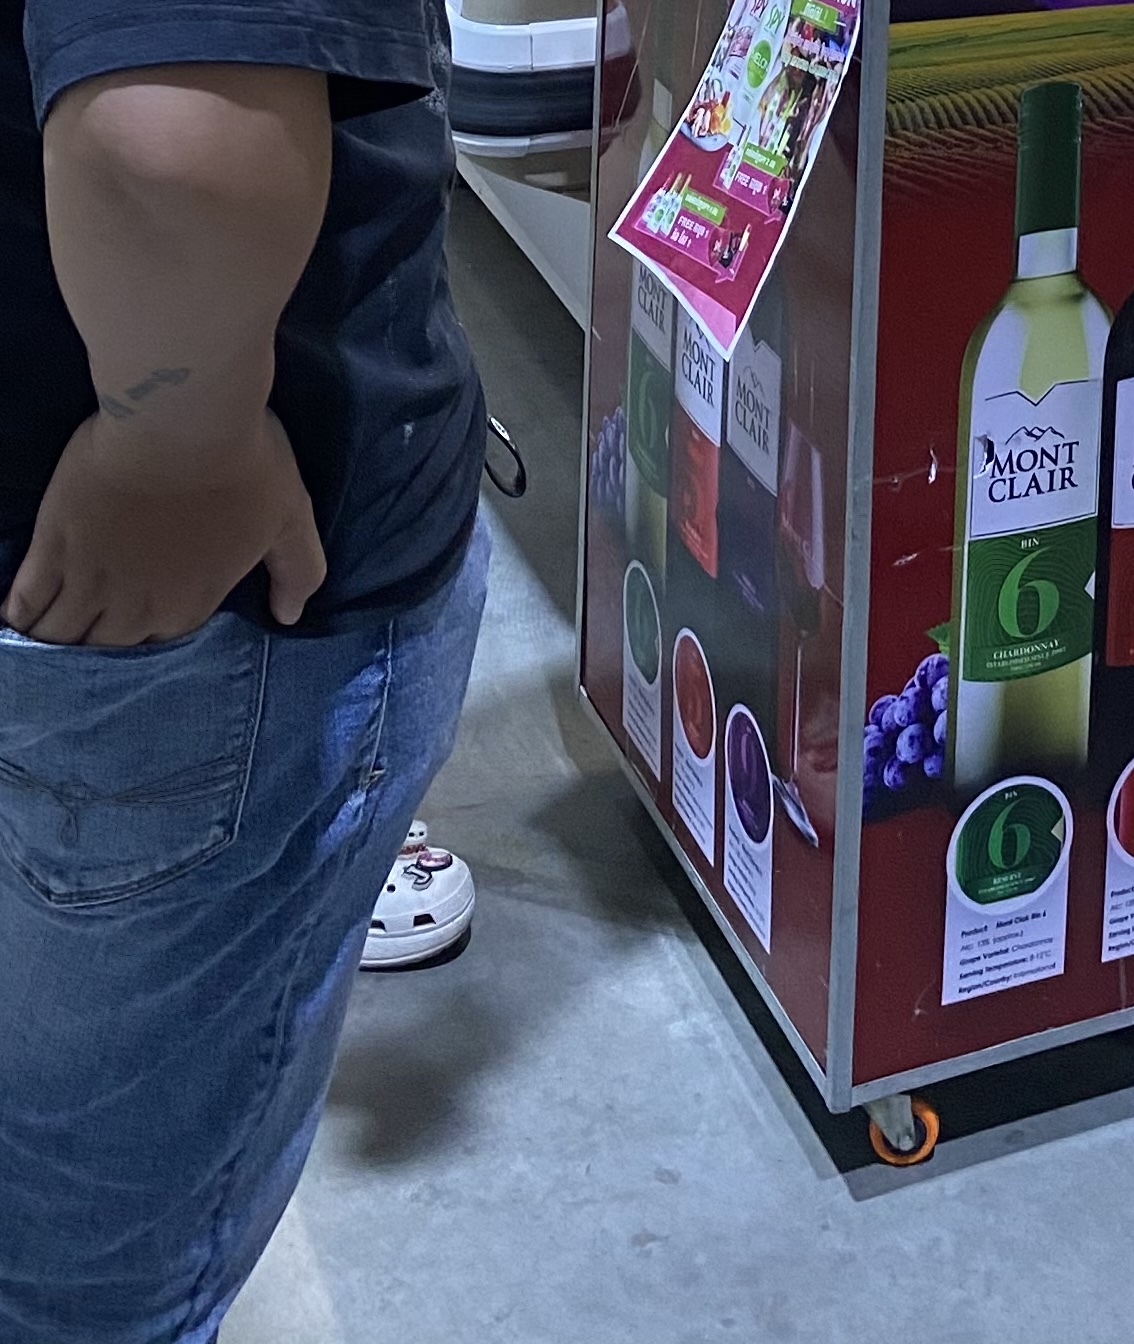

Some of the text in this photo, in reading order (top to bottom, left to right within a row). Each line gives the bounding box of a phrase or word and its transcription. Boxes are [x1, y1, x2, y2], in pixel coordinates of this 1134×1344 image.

[637, 285, 666, 334] CLAIR
[682, 330, 717, 382] MONT
[681, 354, 715, 408] CLAIR
[735, 378, 771, 425] MONT
[734, 401, 770, 454] CLAIR
[989, 440, 1080, 480] MONT
[988, 466, 1079, 504] CLAIR
[1020, 537, 1040, 550] BIN
[998, 546, 1060, 638] 6
[992, 639, 1060, 661] CHARDONNAY
[988, 798, 1031, 870] 6
